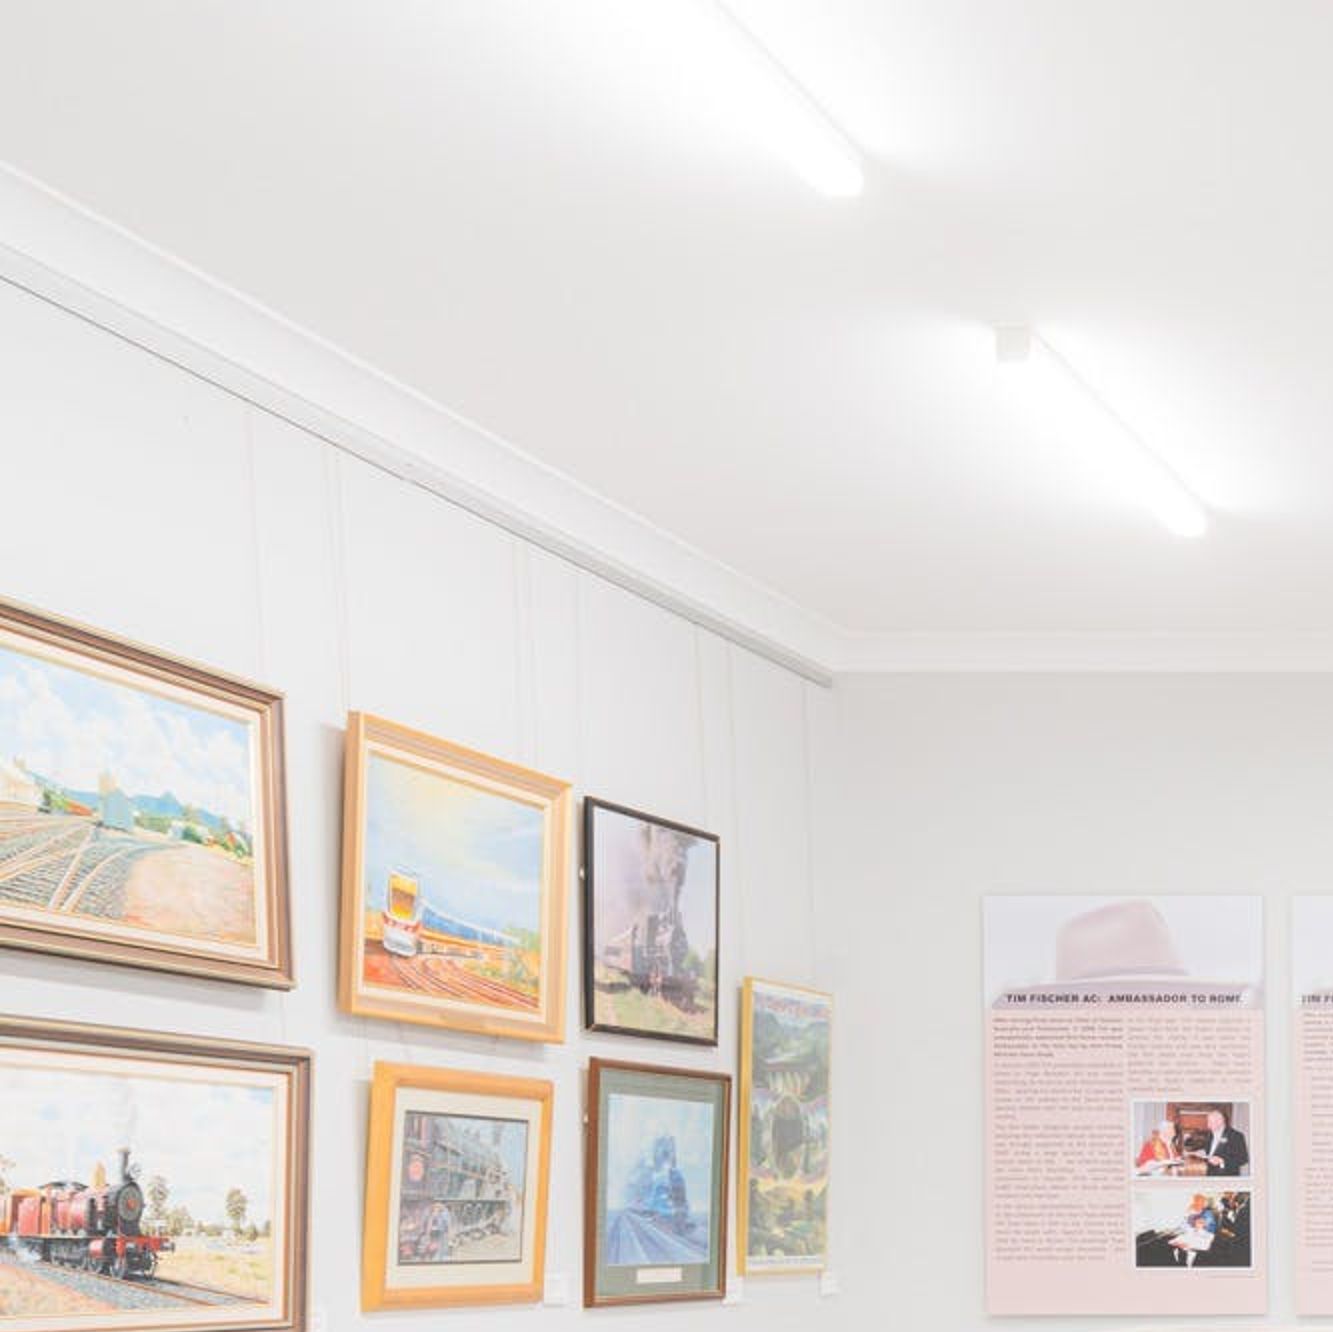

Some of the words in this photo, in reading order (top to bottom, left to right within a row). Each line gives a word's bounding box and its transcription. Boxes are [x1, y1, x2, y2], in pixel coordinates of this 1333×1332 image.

[1006, 993, 1027, 1003] TIM
[1030, 993, 1079, 1003] FISCHER
[1107, 993, 1187, 1004] AMBASSADOR
[1191, 993, 1206, 1004] TO
